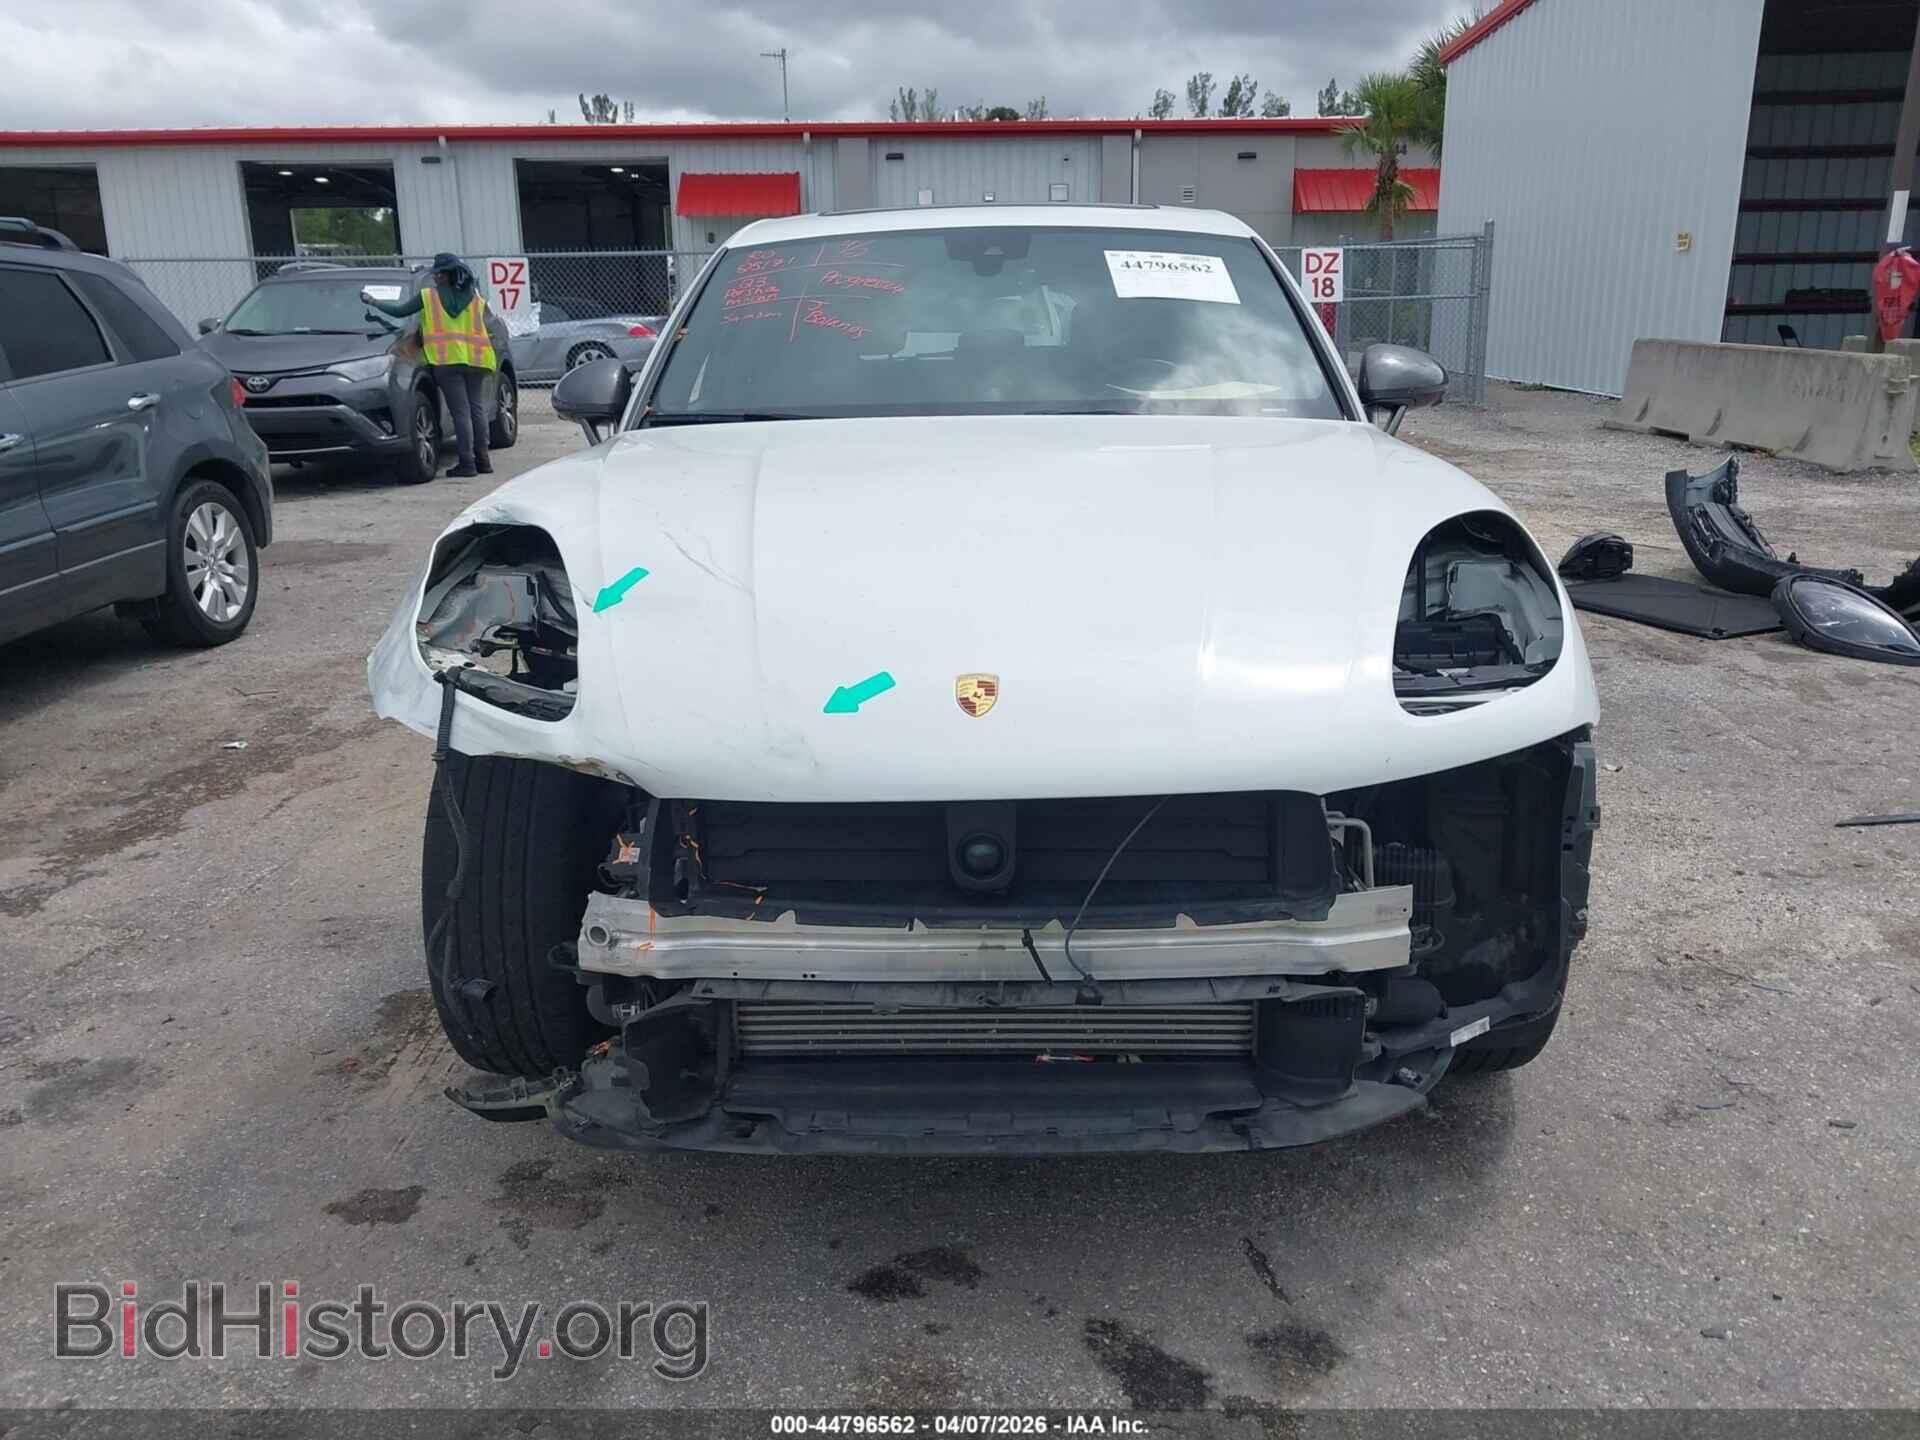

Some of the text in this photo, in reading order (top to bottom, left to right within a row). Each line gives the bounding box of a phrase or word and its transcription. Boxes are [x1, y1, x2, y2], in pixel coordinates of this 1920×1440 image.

[491, 262, 526, 285] DZ
[1120, 260, 1214, 273] 44796562
[1304, 252, 1340, 274] DZ
[1311, 277, 1335, 298] 18
[499, 288, 520, 310] 17
